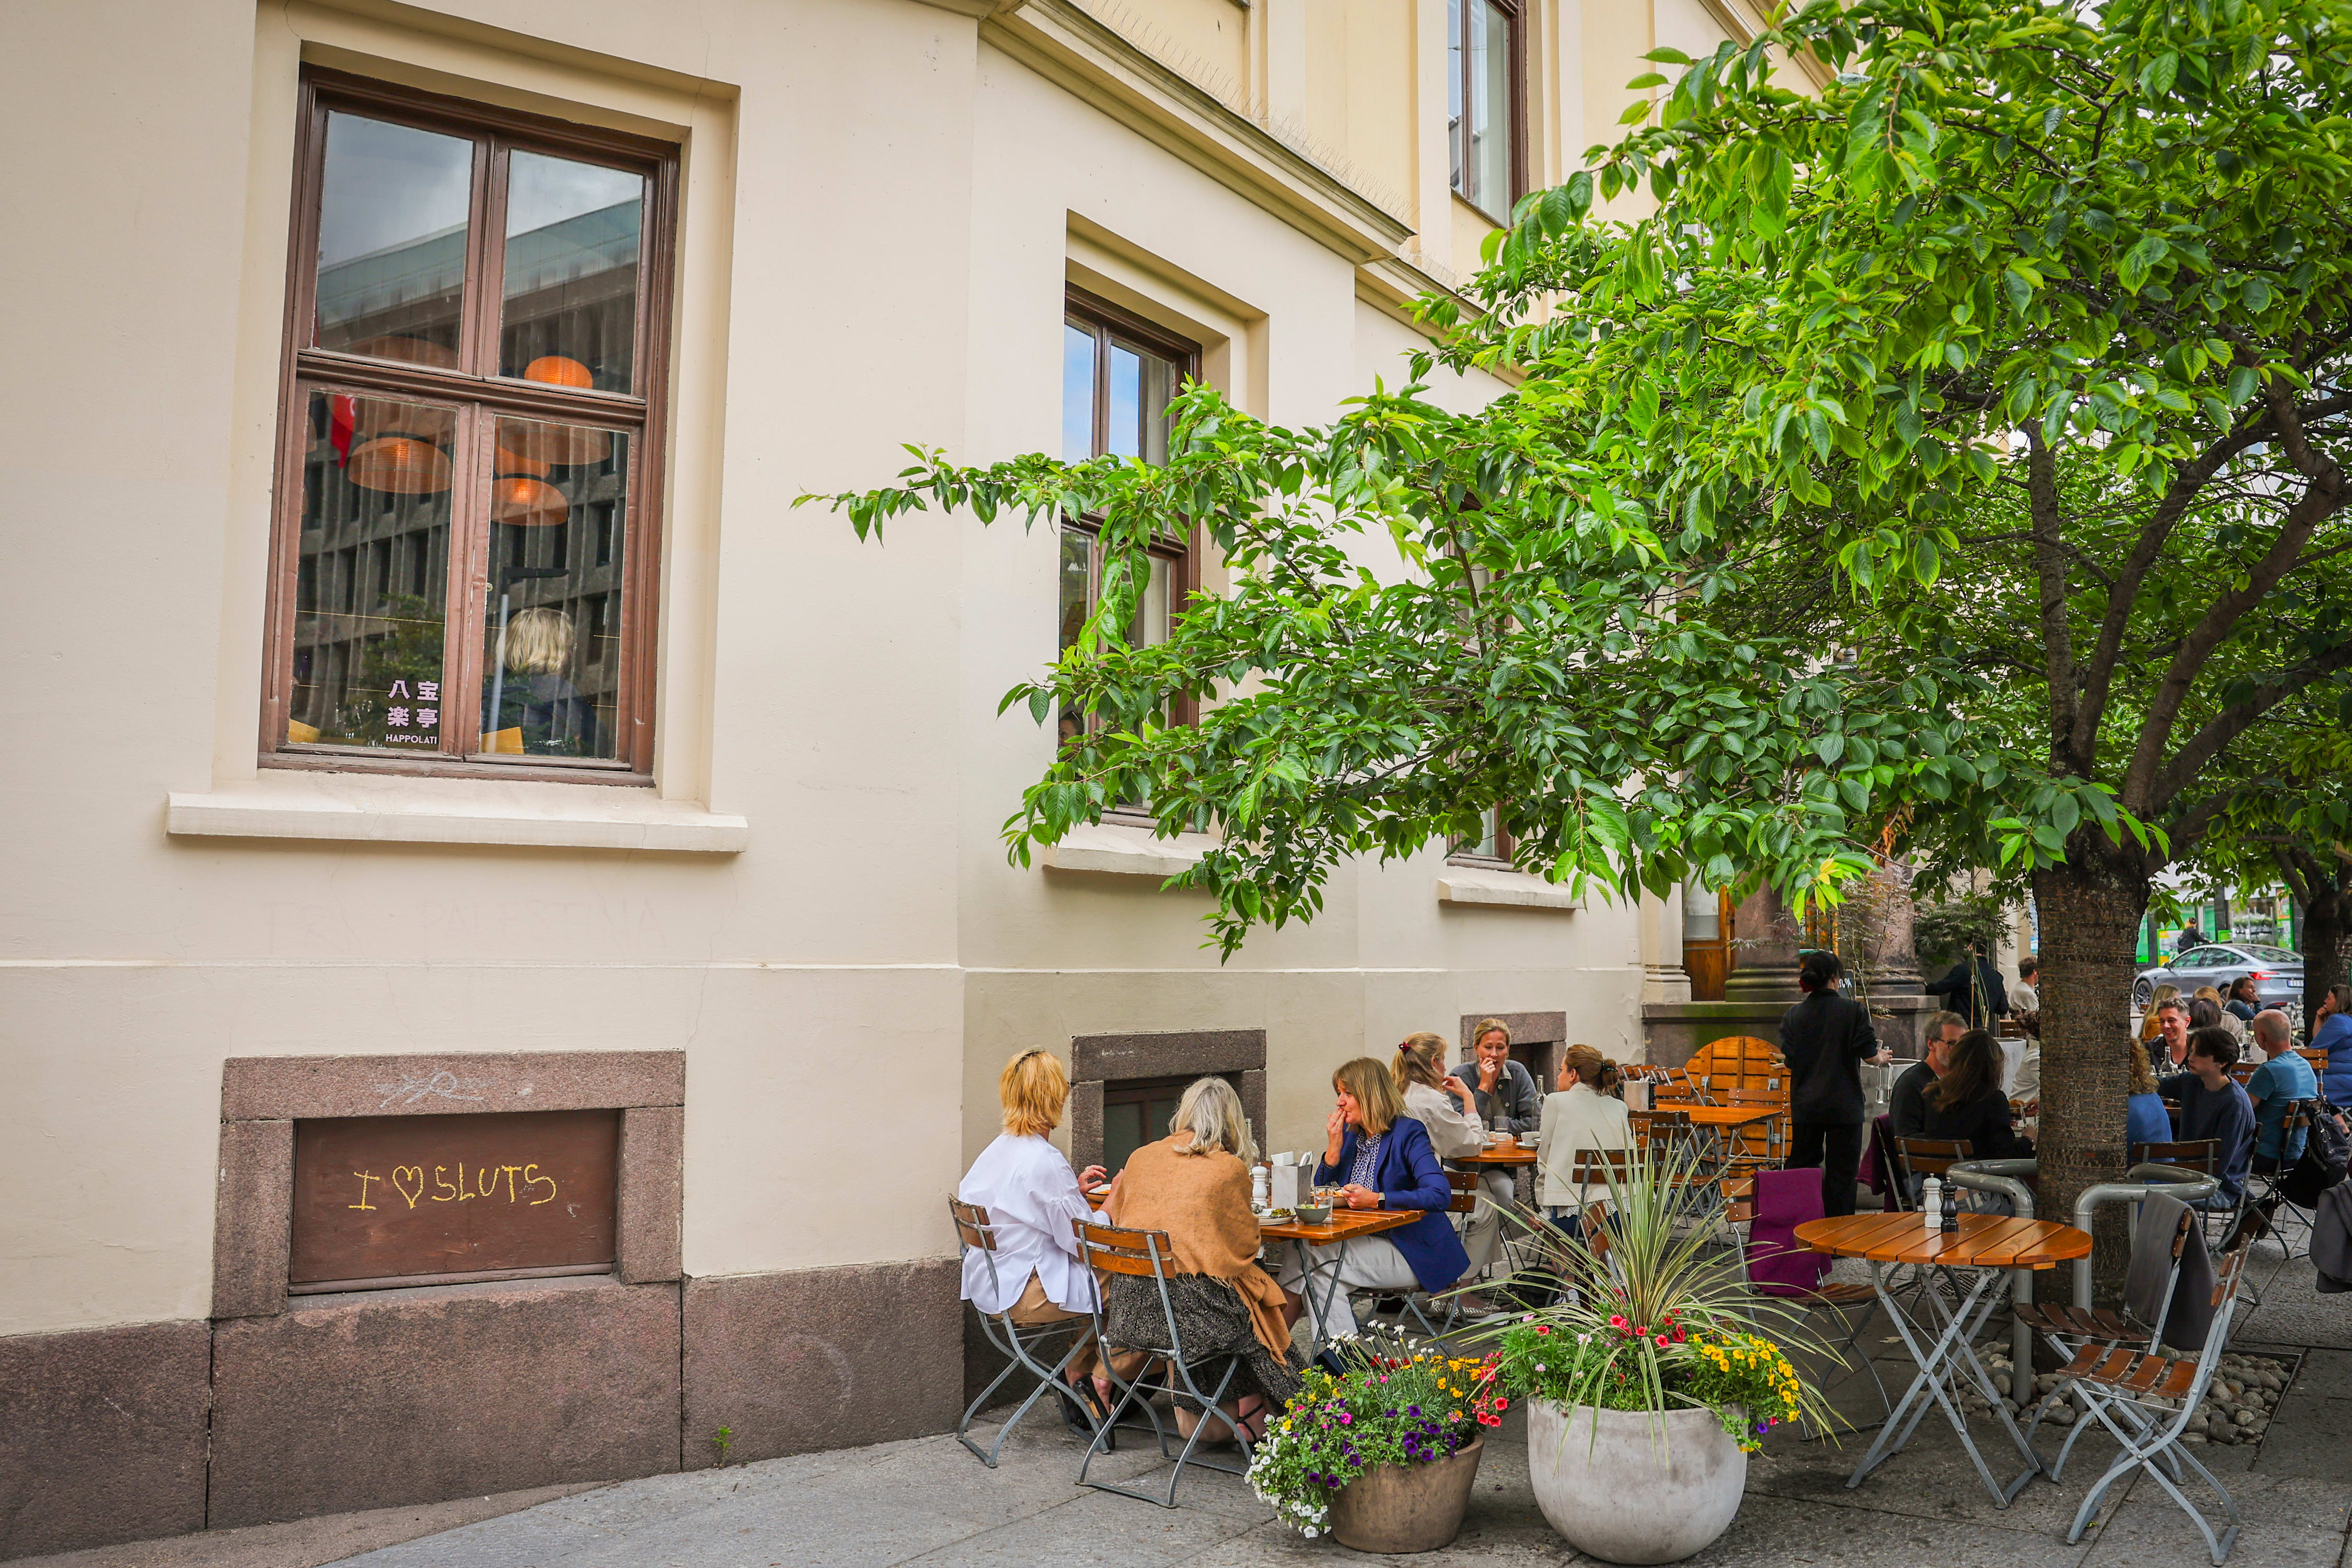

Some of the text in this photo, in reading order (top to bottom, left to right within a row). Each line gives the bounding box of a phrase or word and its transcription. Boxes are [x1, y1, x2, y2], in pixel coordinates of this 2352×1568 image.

[388, 680, 439, 701] 八宝
[387, 706, 438, 728] 楽亭
[386, 734, 437, 744] HAPPOLATI
[349, 1162, 557, 1210] I SLUTS
